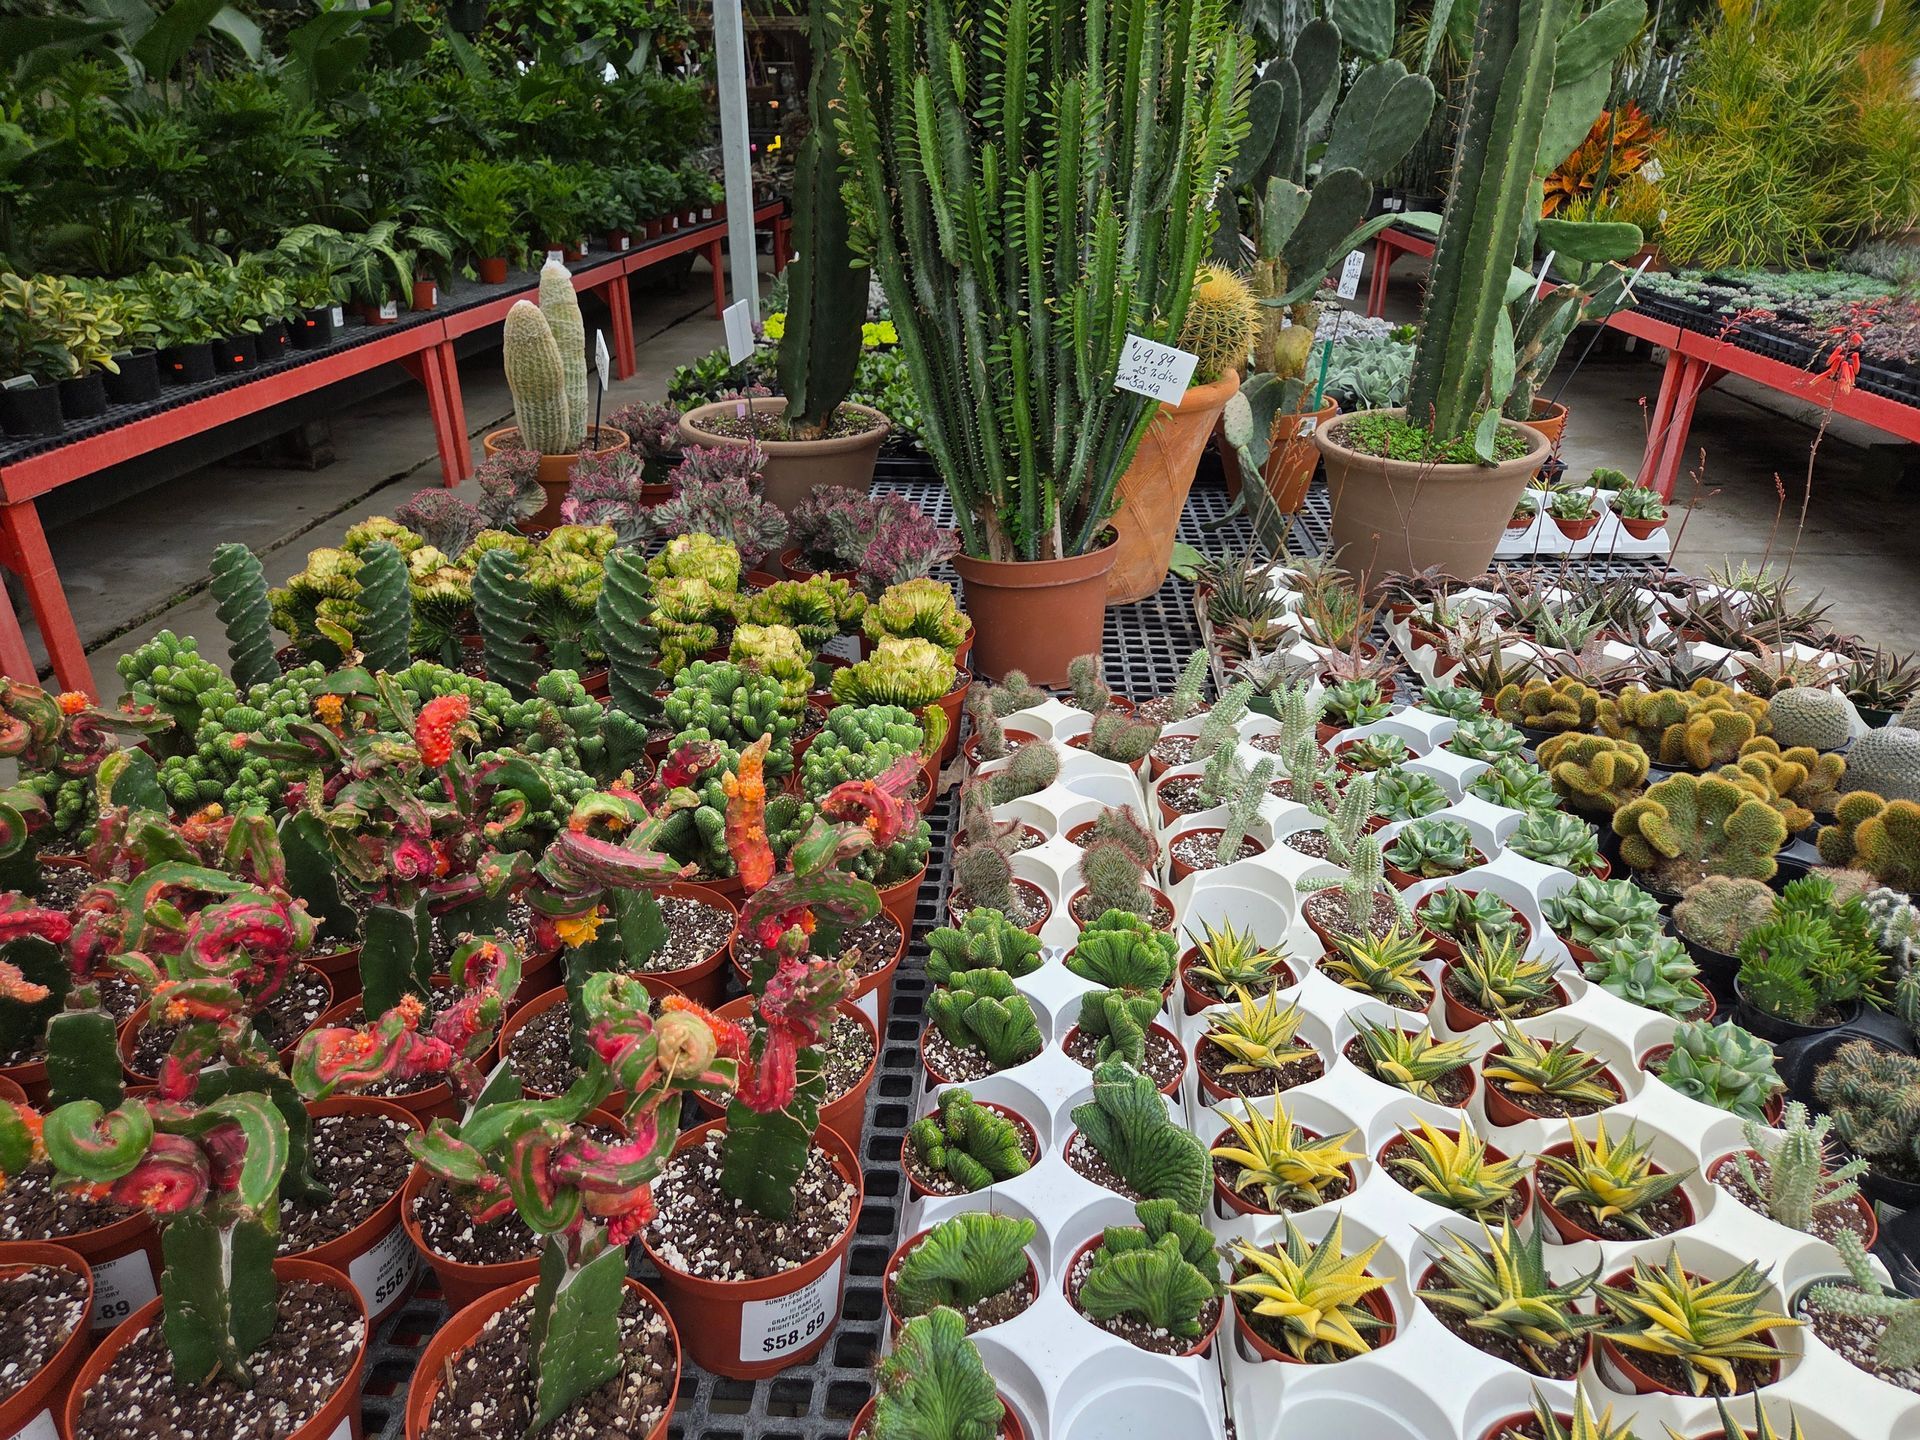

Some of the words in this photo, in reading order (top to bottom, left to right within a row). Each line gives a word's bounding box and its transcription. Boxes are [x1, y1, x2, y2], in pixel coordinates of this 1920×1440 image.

[764, 1297, 786, 1306] SUNNY
[788, 1289, 804, 1300] SPOT
[797, 1298, 813, 1311] RARE
[771, 1311, 800, 1326] GRAFTED
[800, 1299, 821, 1316] CACTUS
[762, 1311, 825, 1353] $58.89
[767, 1322, 790, 1333] BRIGHT
